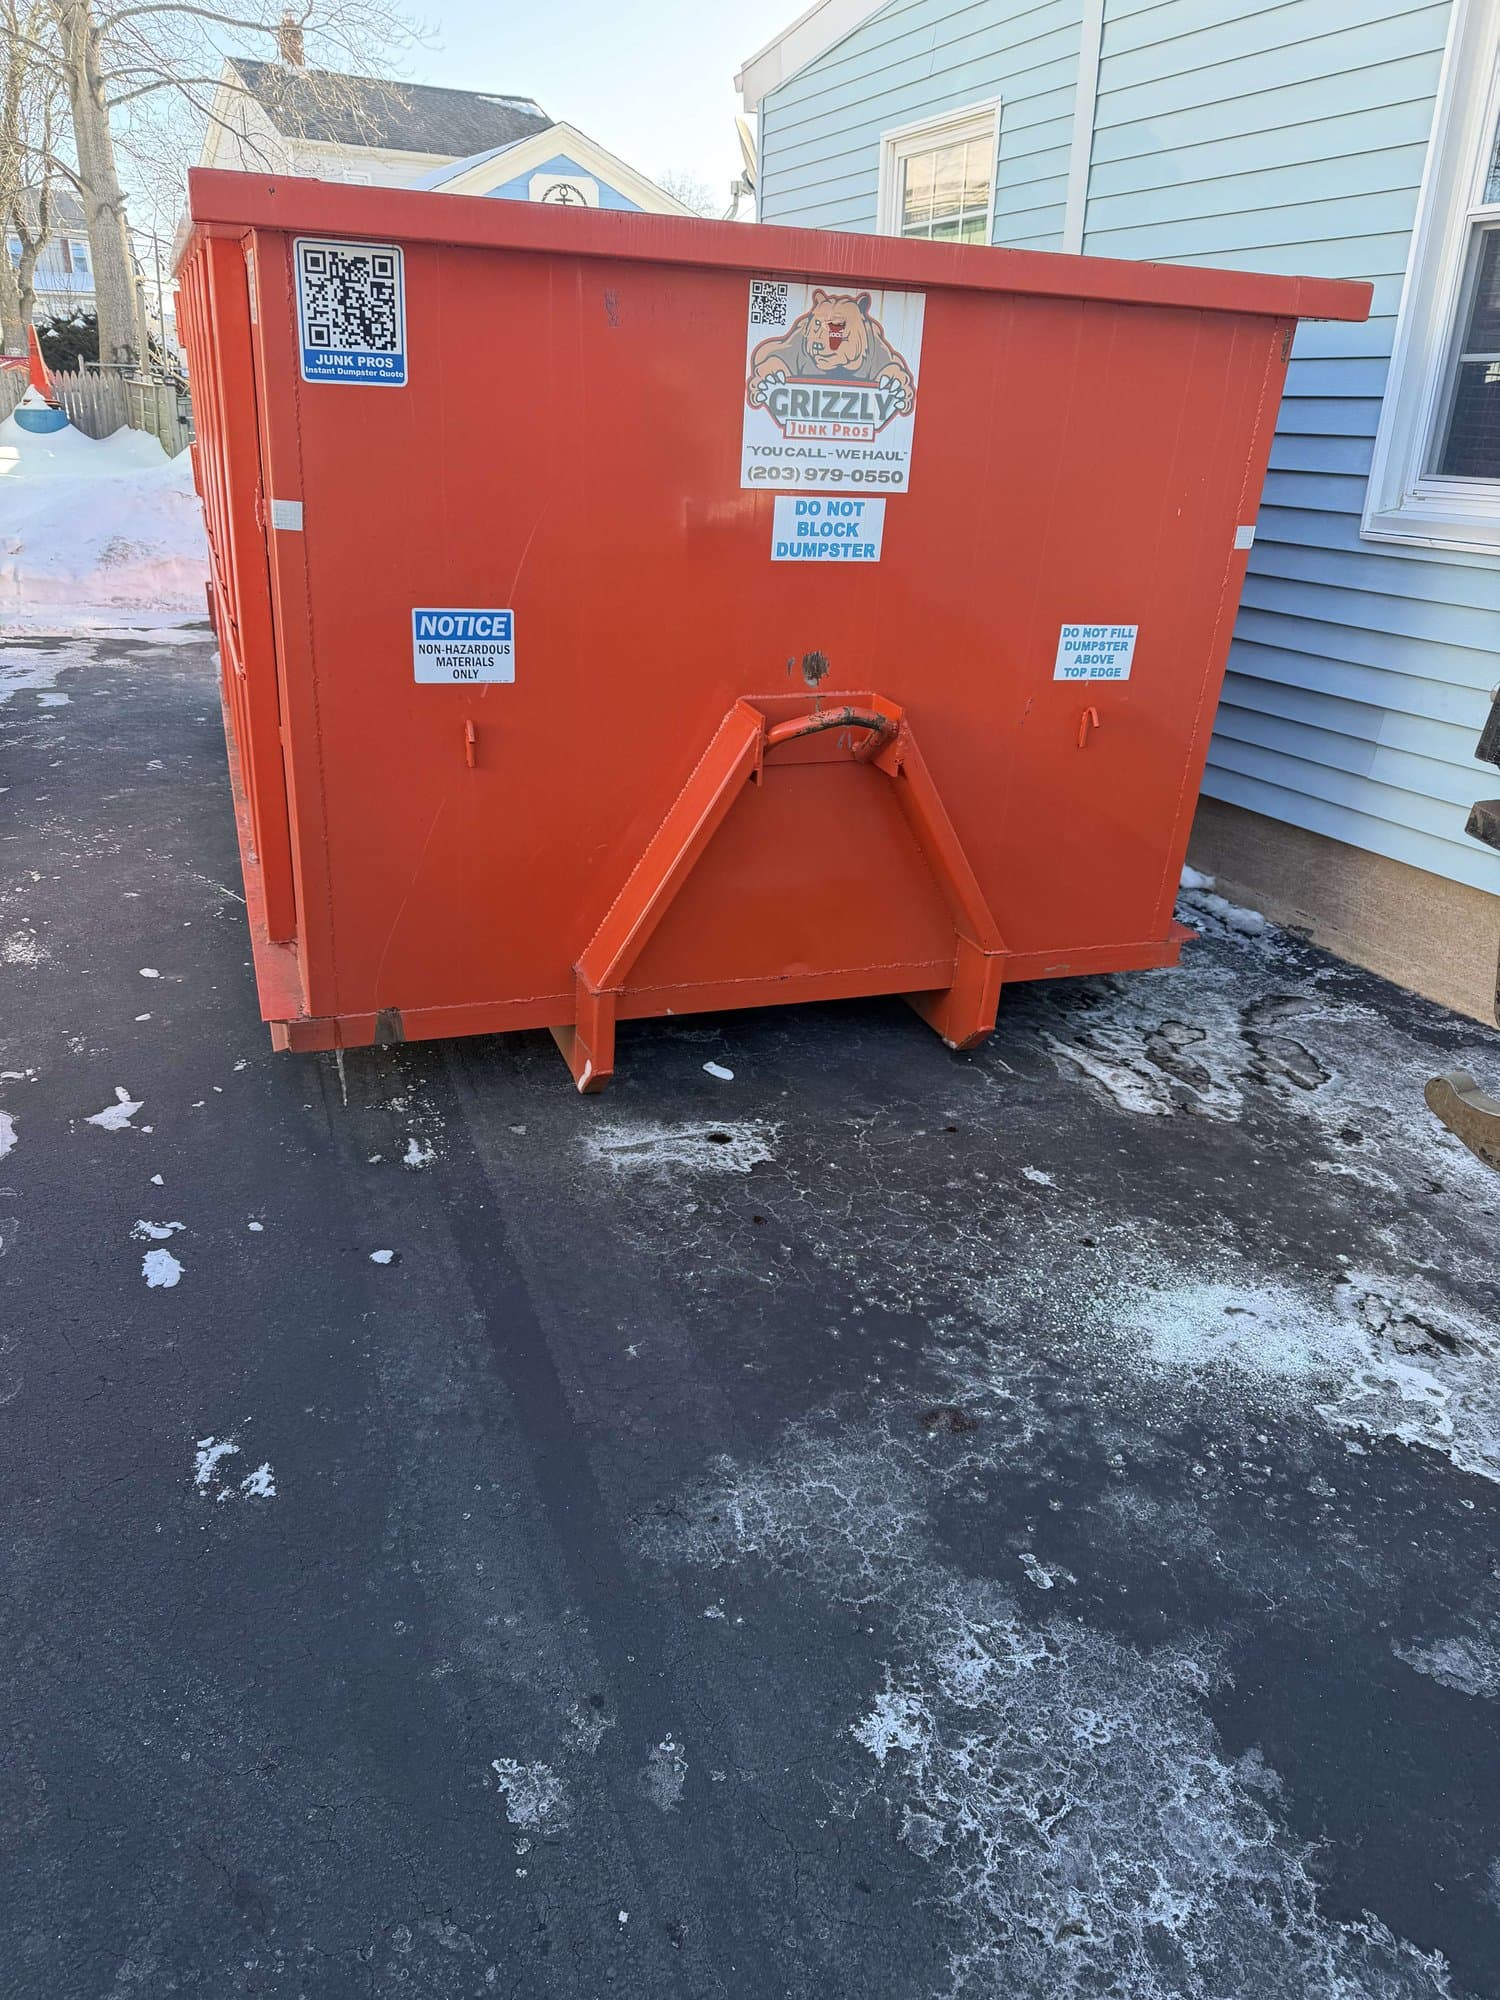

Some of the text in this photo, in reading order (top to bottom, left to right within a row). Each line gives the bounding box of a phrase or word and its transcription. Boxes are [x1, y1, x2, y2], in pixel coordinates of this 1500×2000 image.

[316, 354, 394, 368] JUNK PROS
[305, 366, 403, 378] Instant Dumpster Quote
[769, 388, 895, 421] GRIZZLY
[747, 465, 904, 484] (203) 979-0550
[795, 500, 865, 517] DO NOT
[797, 521, 860, 537] BLOCK
[776, 542, 875, 558] DUMPSTER
[420, 615, 507, 637] NOTICE
[1062, 627, 1134, 638] DO NOT FILL
[418, 644, 511, 655] NON-HAZARDOUS
[1064, 641, 1129, 652] DUMPSTER
[436, 656, 495, 667] MATERIALS
[1074, 654, 1115, 665] ABOVE
[452, 669, 480, 680] ONLY
[1063, 667, 1122, 678] TOP EDGE
